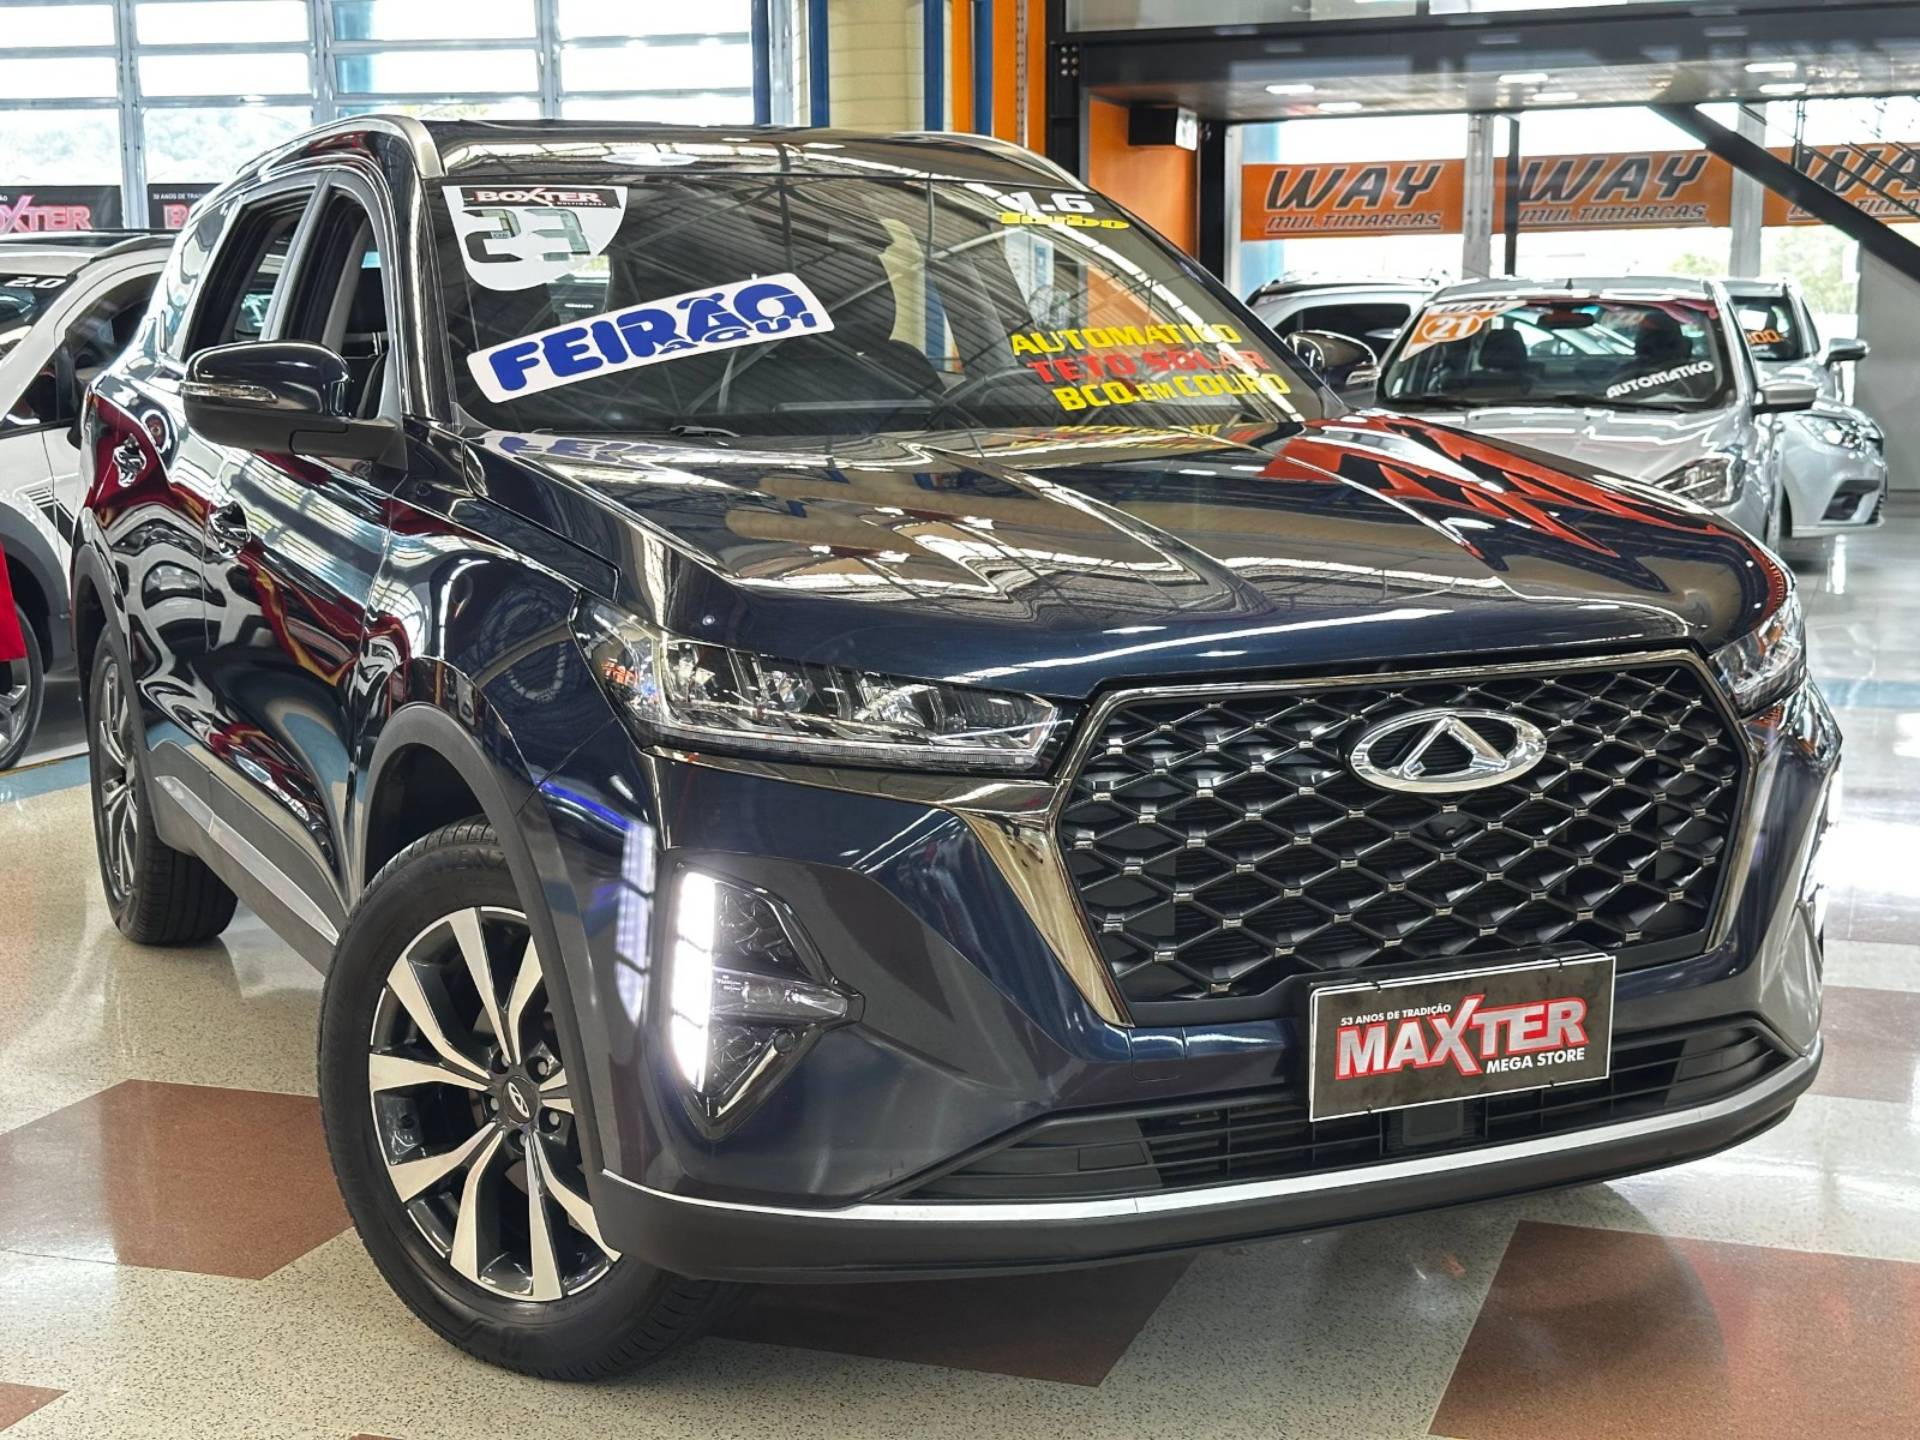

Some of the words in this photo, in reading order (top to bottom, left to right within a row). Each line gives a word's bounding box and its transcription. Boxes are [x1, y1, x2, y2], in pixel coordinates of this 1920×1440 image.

[1264, 162, 1446, 212] WAY
[1515, 155, 1709, 204] WAY
[1800, 148, 1920, 196] WA
[0, 194, 92, 233] XTER
[475, 188, 605, 207] BOXTER
[1010, 192, 1095, 213] 1.6
[1267, 213, 1441, 230] MULTIMARCAS
[4, 276, 67, 288] 2.0
[489, 283, 808, 391] FEIRÃO
[658, 312, 817, 355] AQUI
[1027, 353, 1137, 383] TETO
[1173, 373, 1291, 397] COURO
[1606, 360, 1714, 399] AUTOMATICO
[1341, 1016, 1353, 1026] 53
[1355, 1013, 1385, 1025] ANOS
[1387, 1010, 1400, 1021] DE
[1402, 1003, 1452, 1018] TRADIÇÃO
[1336, 994, 1589, 1080] MAXTER
[1486, 1057, 1534, 1074] MEGA
[1537, 1047, 1585, 1066] STORE
